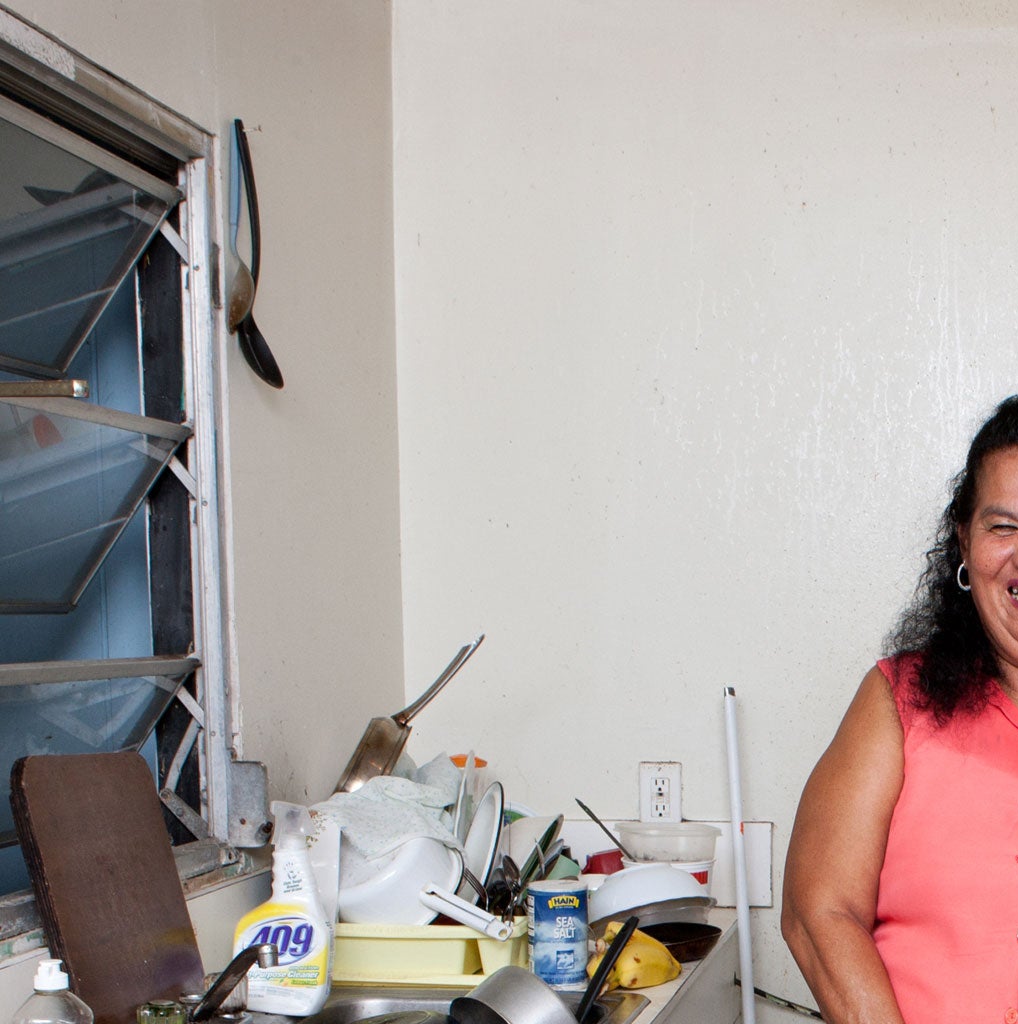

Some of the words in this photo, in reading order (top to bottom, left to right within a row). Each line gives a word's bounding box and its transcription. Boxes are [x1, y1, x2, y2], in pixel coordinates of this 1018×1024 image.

[554, 897, 575, 905] HAIN
[556, 916, 575, 928] SEA
[553, 927, 577, 938] SALT
[250, 923, 313, 957] 409
